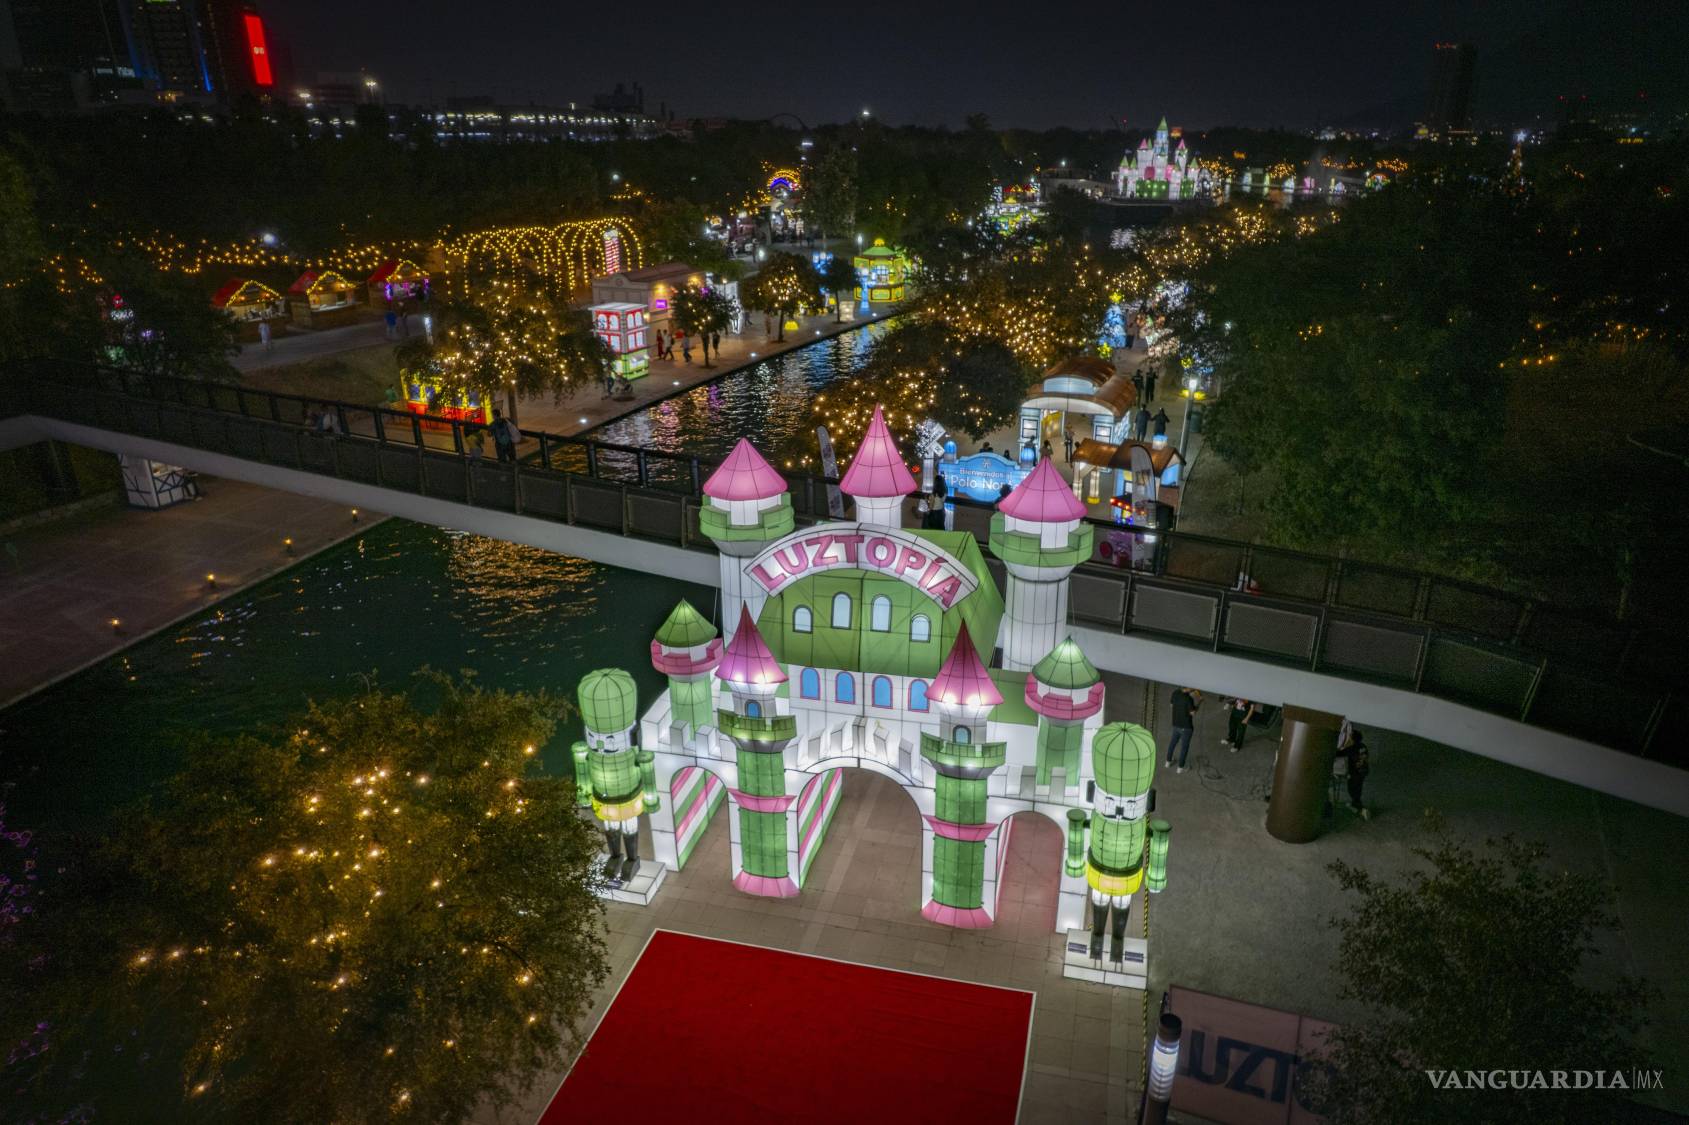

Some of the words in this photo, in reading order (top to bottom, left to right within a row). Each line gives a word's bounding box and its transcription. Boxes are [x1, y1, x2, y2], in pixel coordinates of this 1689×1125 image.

[960, 467, 1004, 480] Bienvenidos
[951, 474, 977, 488] Polo
[751, 534, 962, 607] LUZTOPÍA
